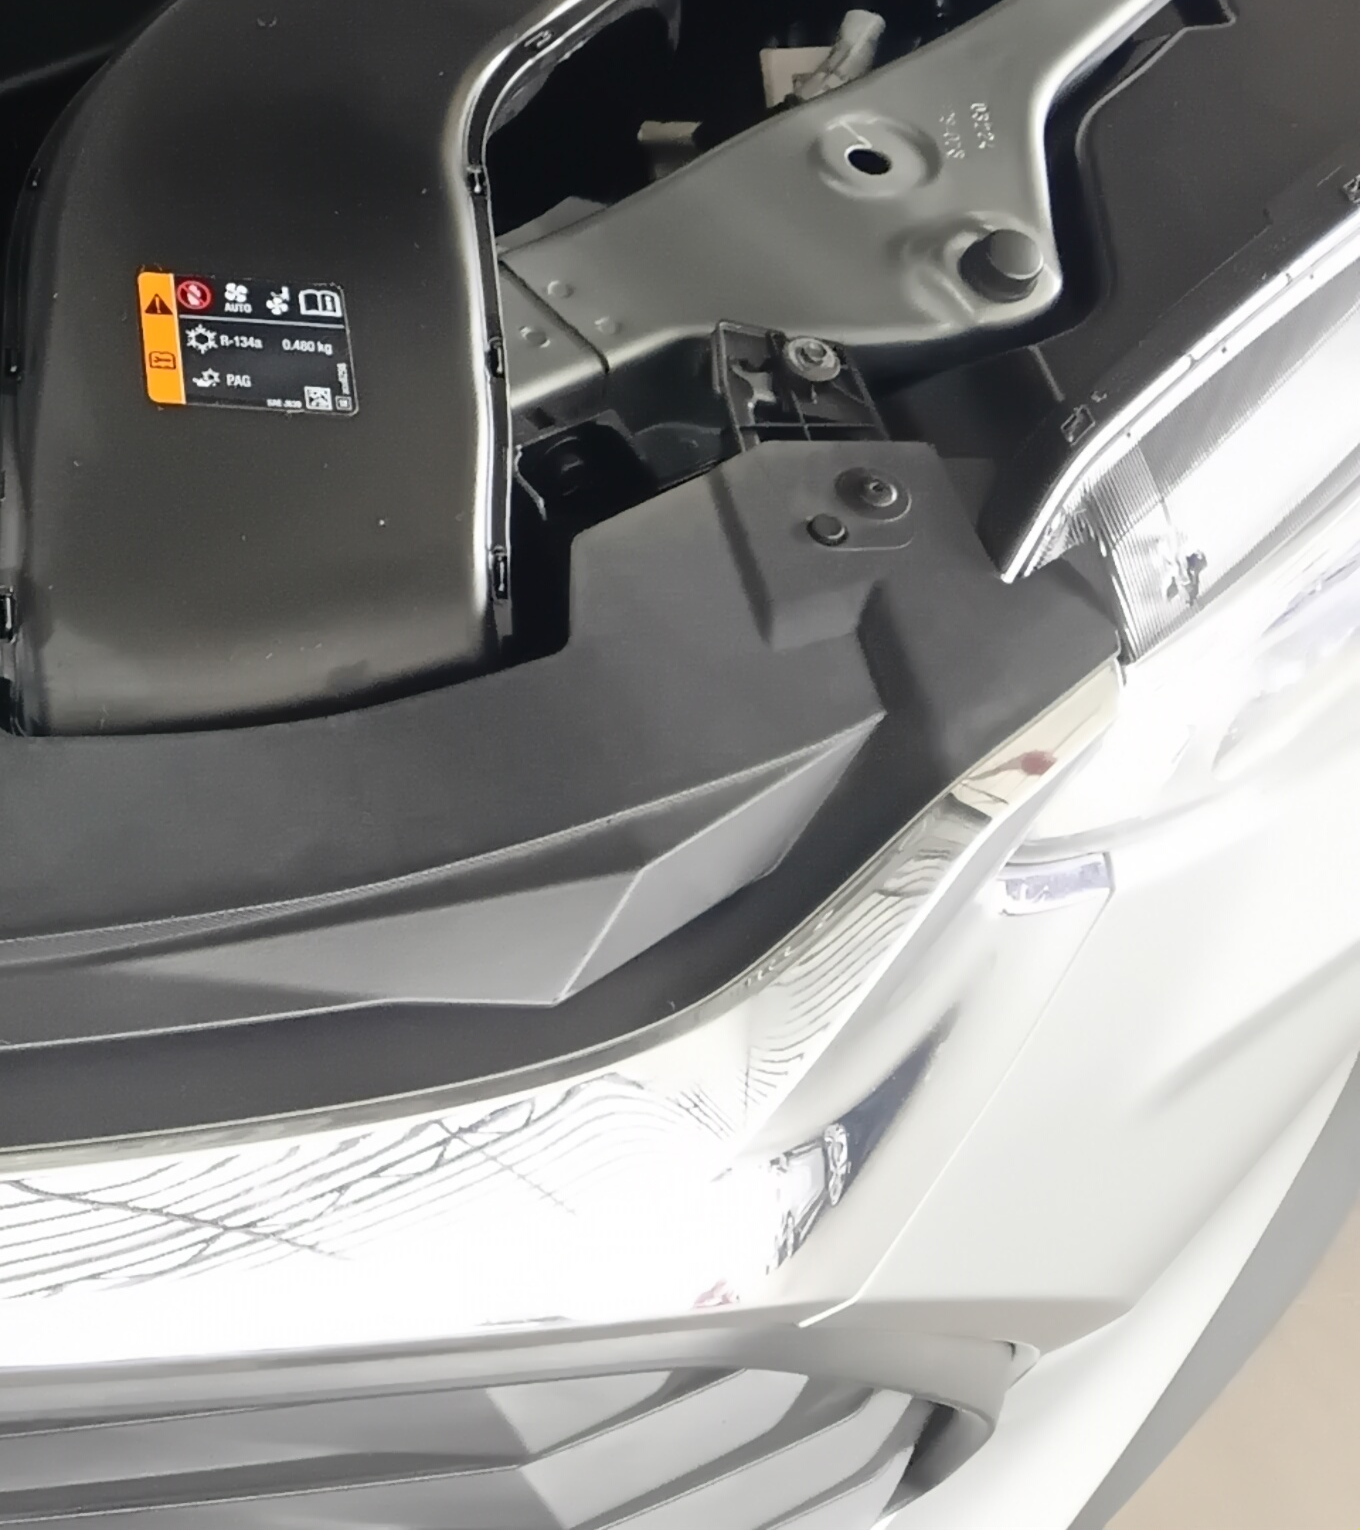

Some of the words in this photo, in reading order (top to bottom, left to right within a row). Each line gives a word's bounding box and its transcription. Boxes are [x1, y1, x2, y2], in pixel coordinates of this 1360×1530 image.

[224, 302, 253, 314] AUTO
[219, 334, 263, 349] R-134a
[317, 340, 333, 355] kg
[226, 373, 252, 388] PAG
